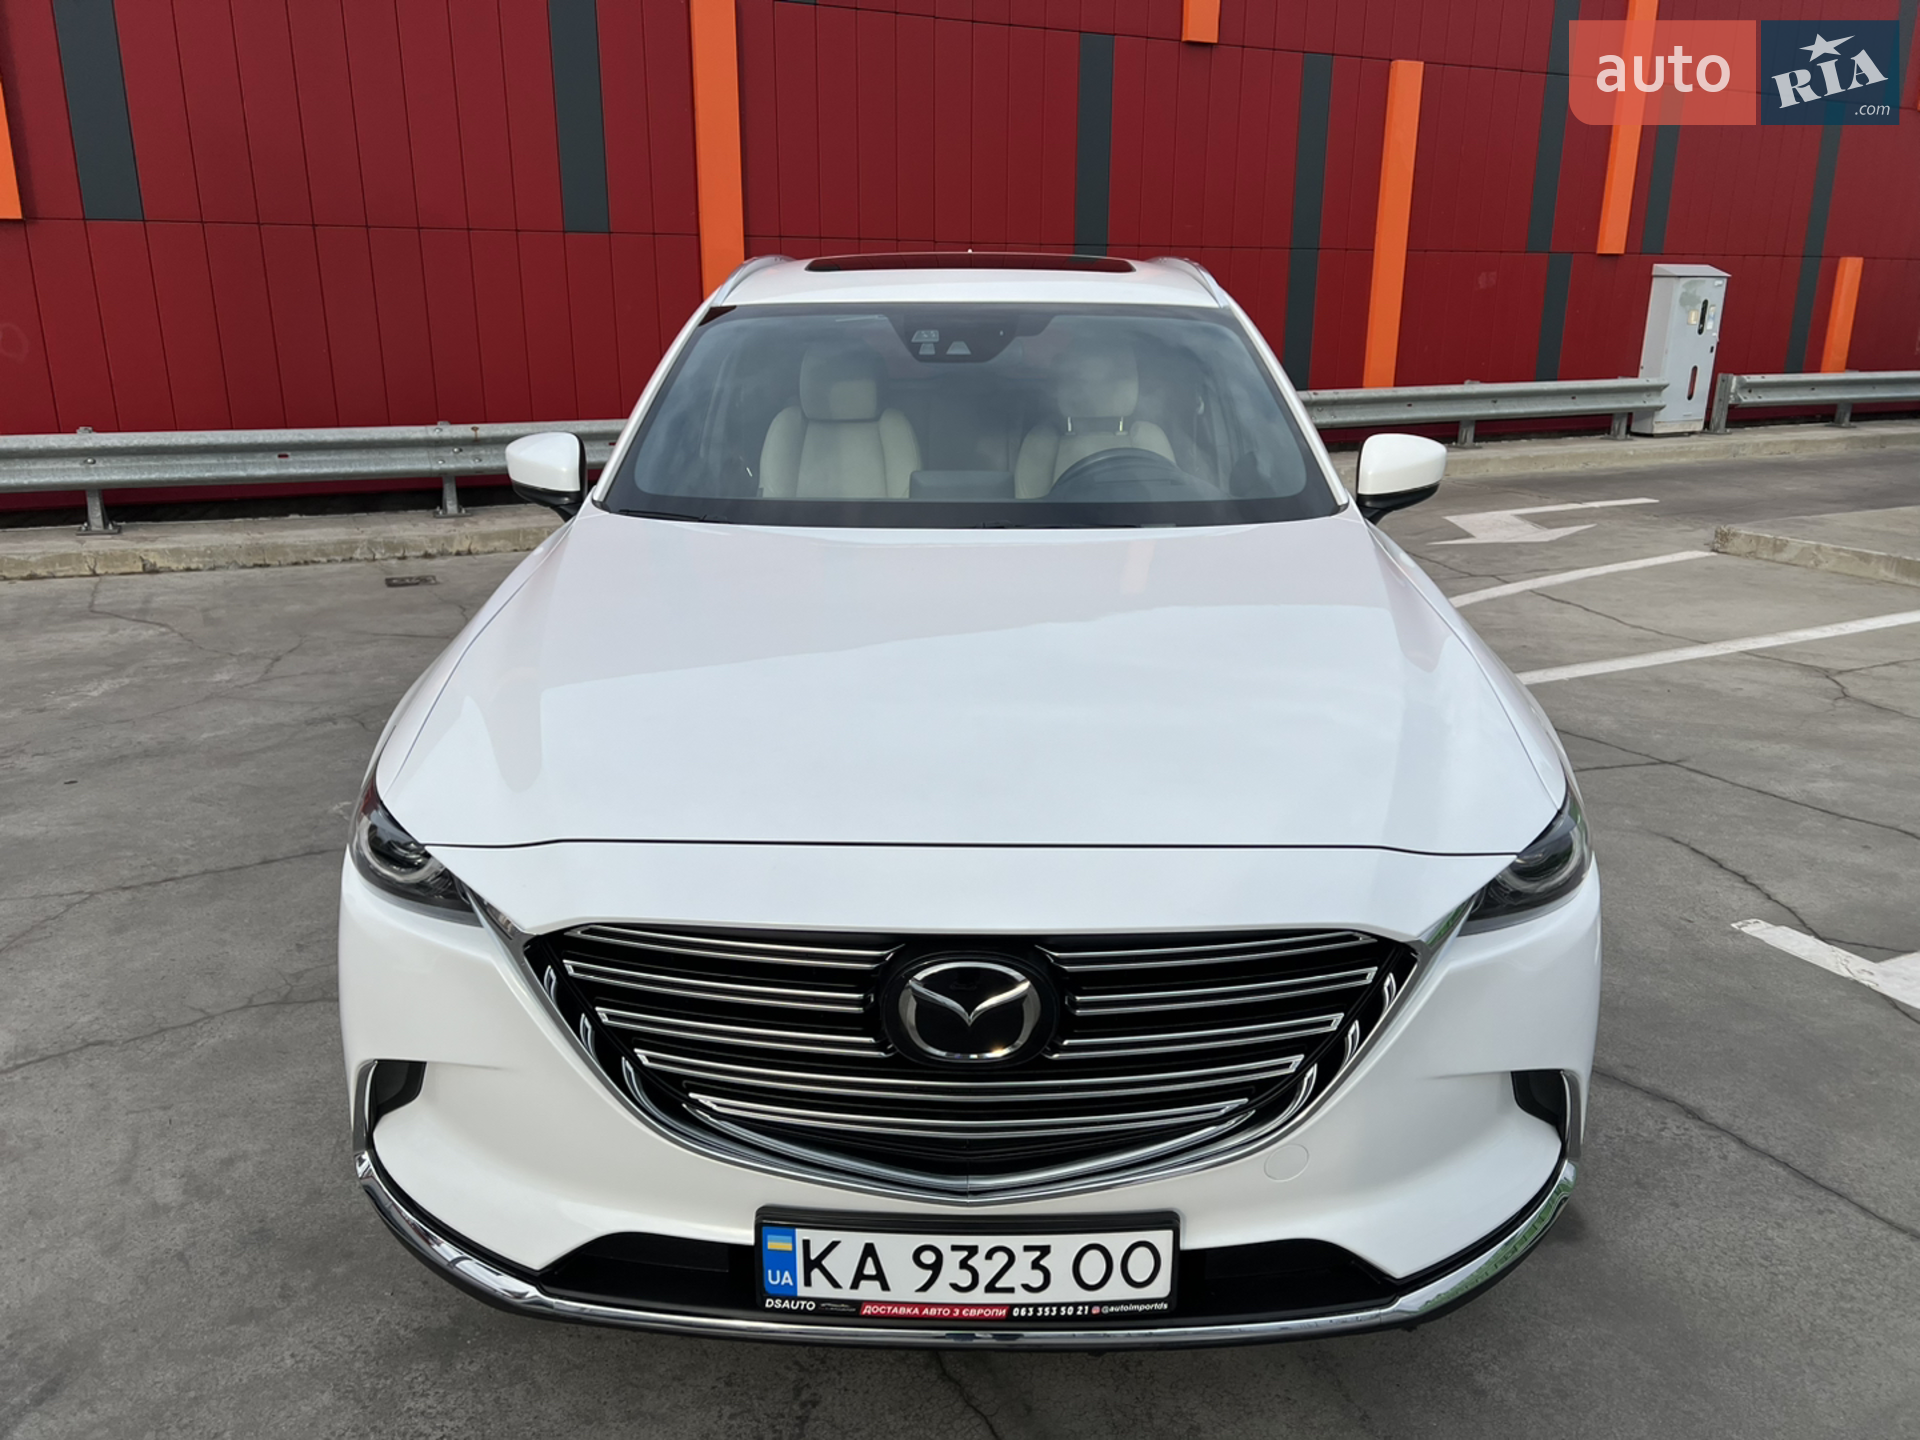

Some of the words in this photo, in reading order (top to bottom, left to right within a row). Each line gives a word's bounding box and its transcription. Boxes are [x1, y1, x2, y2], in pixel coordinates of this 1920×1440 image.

[802, 1238, 891, 1292] KA
[911, 1244, 1052, 1294] 9323
[1071, 1240, 1162, 1292] OO
[768, 1270, 793, 1286] UA
[765, 1298, 816, 1311] DSAUTO
[862, 1305, 920, 1315] ДОСТАВКА
[921, 1307, 951, 1316] АВТО
[961, 1308, 1007, 1317] ЄВРОПИ
[1012, 1307, 1034, 1316] 063
[1036, 1306, 1057, 1316] 353
[1060, 1306, 1074, 1315] 50
[1076, 1305, 1089, 1315] 21
